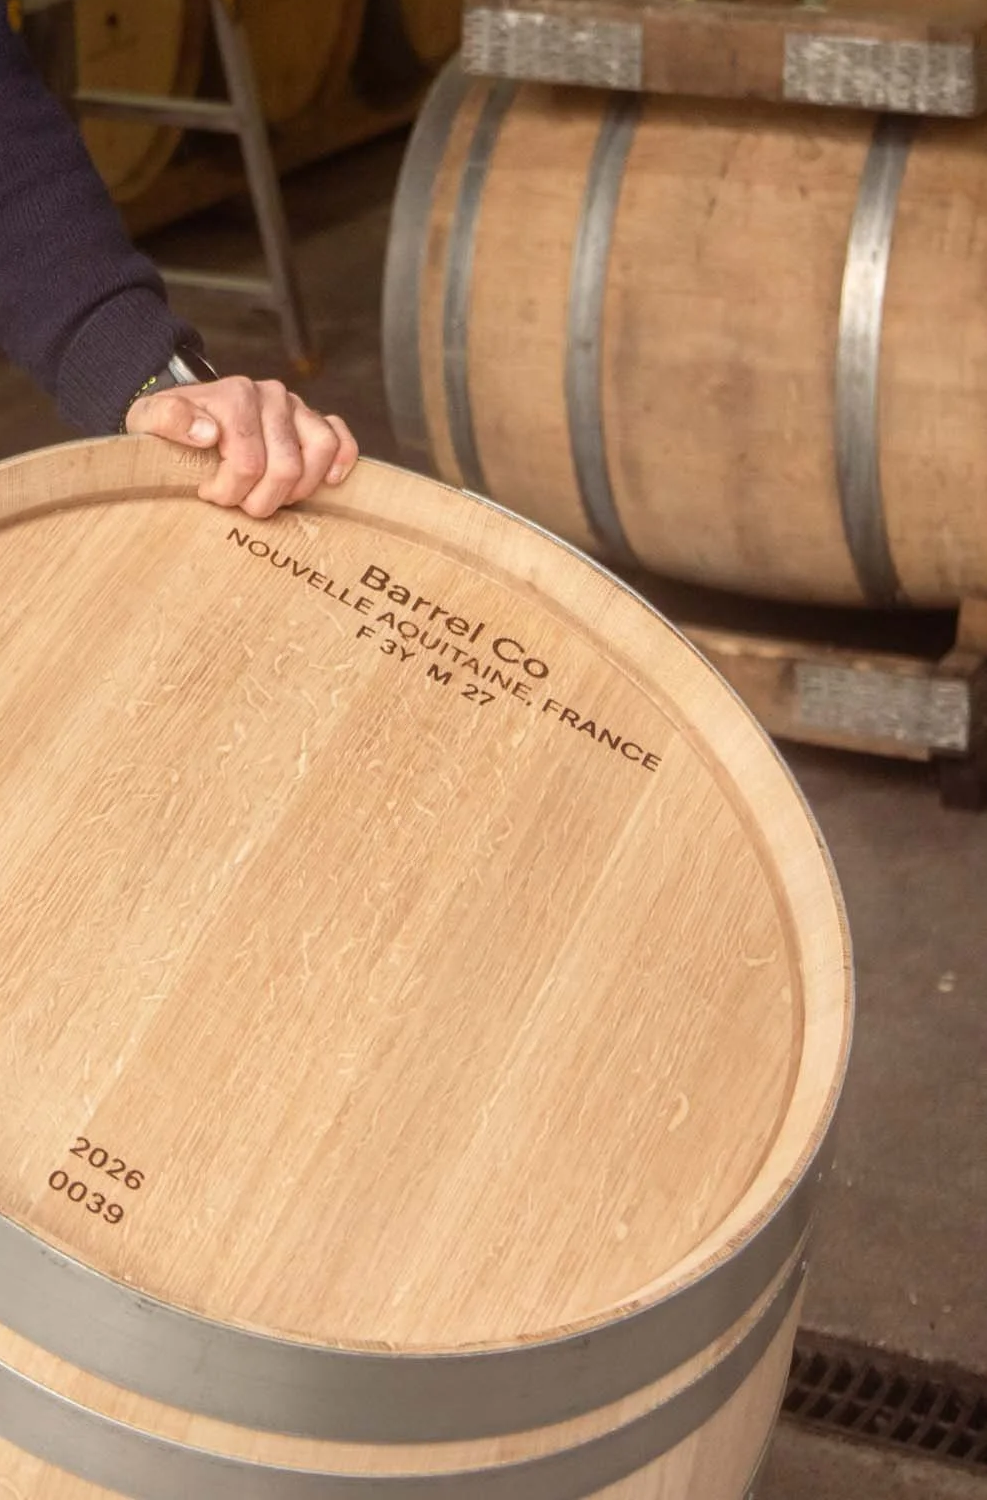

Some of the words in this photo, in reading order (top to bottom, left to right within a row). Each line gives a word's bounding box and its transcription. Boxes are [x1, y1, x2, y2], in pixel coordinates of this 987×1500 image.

[360, 564, 485, 643] Barrel
[492, 637, 550, 679] Co
[227, 528, 374, 615] NOUVELLE
[376, 611, 532, 706] AQUITAINE,
[542, 698, 662, 772] FRANCE
[426, 663, 453, 686] M
[461, 683, 496, 706] 27
[69, 1136, 145, 1190] 2026
[48, 1170, 124, 1224] 0039
